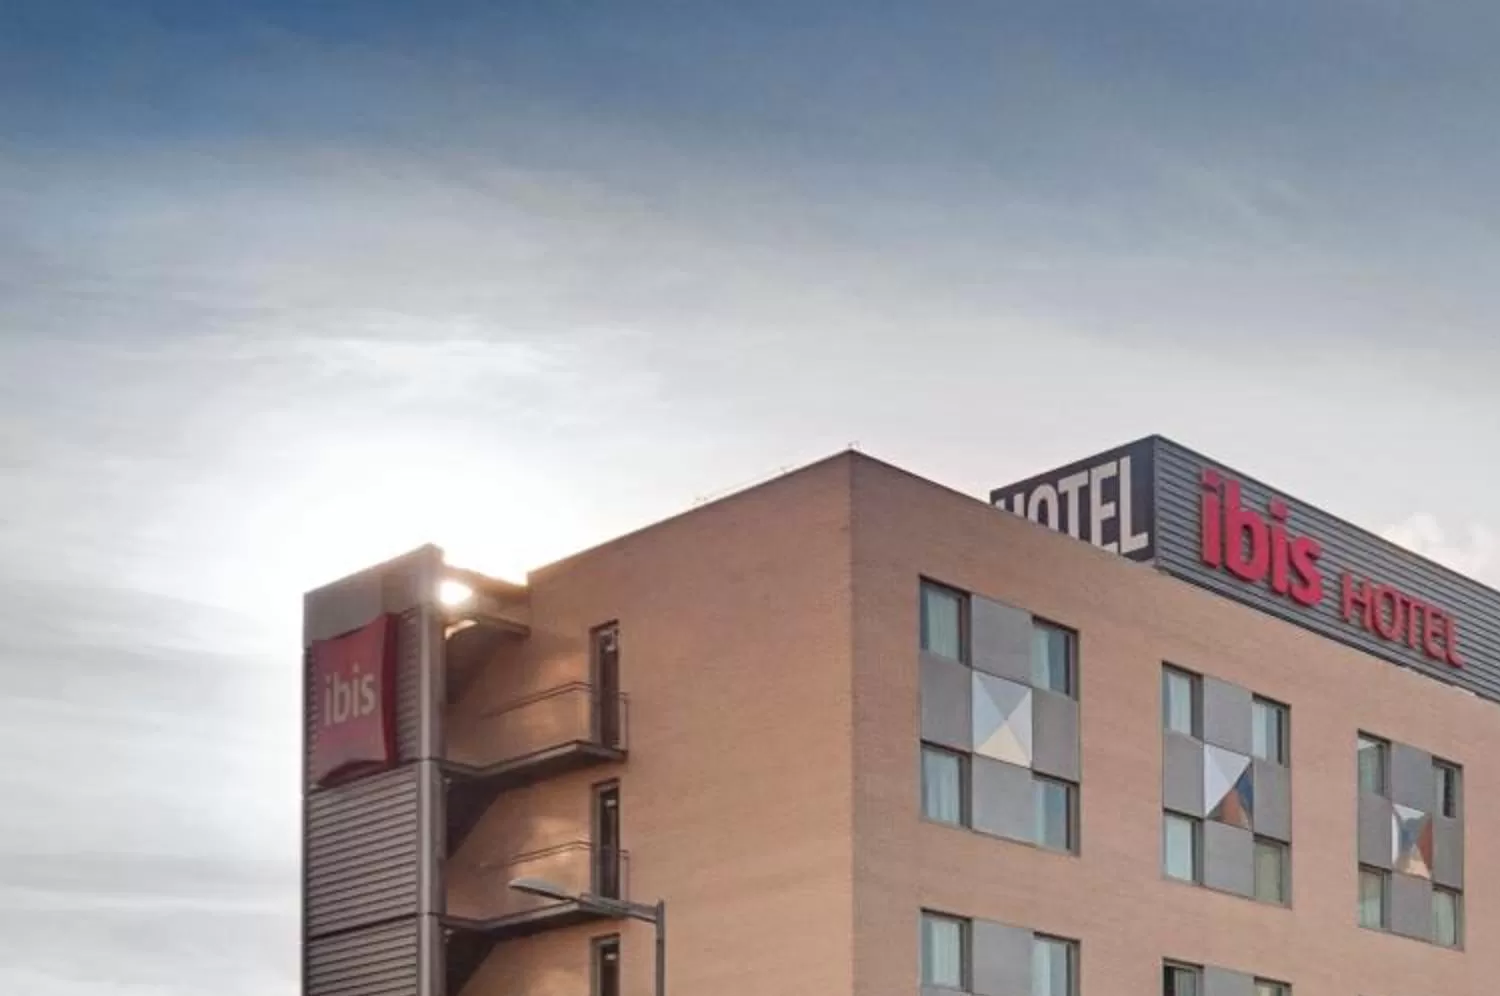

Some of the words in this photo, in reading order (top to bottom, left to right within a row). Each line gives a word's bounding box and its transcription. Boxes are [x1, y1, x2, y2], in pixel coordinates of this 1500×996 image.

[993, 456, 1149, 555] OTEL
[1202, 469, 1323, 606] ibis
[1342, 570, 1464, 669] HOTEL
[324, 662, 376, 726] ibis
